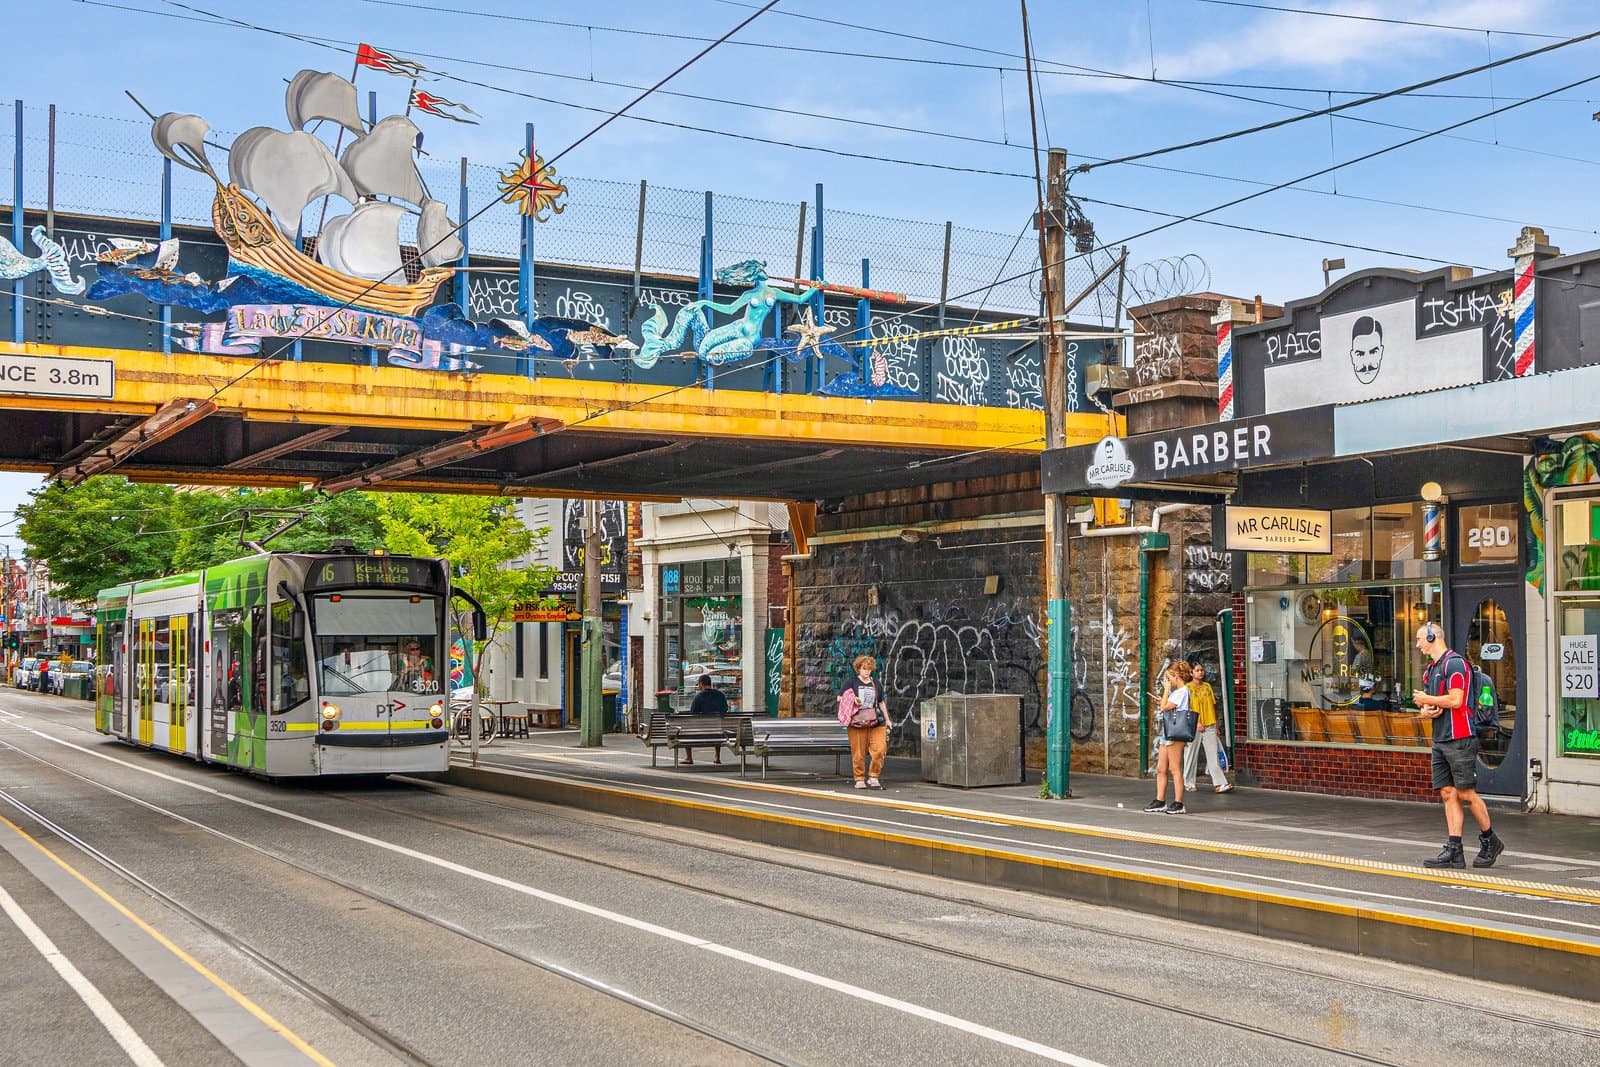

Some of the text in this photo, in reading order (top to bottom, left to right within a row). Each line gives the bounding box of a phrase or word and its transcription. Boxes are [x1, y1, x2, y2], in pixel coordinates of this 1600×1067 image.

[237, 308, 297, 336] Lady
[362, 315, 418, 346] Kilda
[48, 368, 99, 386] 3.8m
[1154, 425, 1271, 470] BARBER
[1090, 467, 1099, 479] MR
[1100, 463, 1131, 474] CARLISLE
[1237, 516, 1322, 538] MR CARLISLE
[1468, 526, 1509, 547] 290
[322, 564, 335, 582] 16
[600, 573, 621, 583] FISH
[1569, 641, 1589, 649] HUGE
[1563, 650, 1595, 665] SALE
[412, 680, 439, 692] 3520
[1565, 672, 1593, 691] $20
[376, 704, 394, 718] PT
[270, 720, 287, 732] 3520
